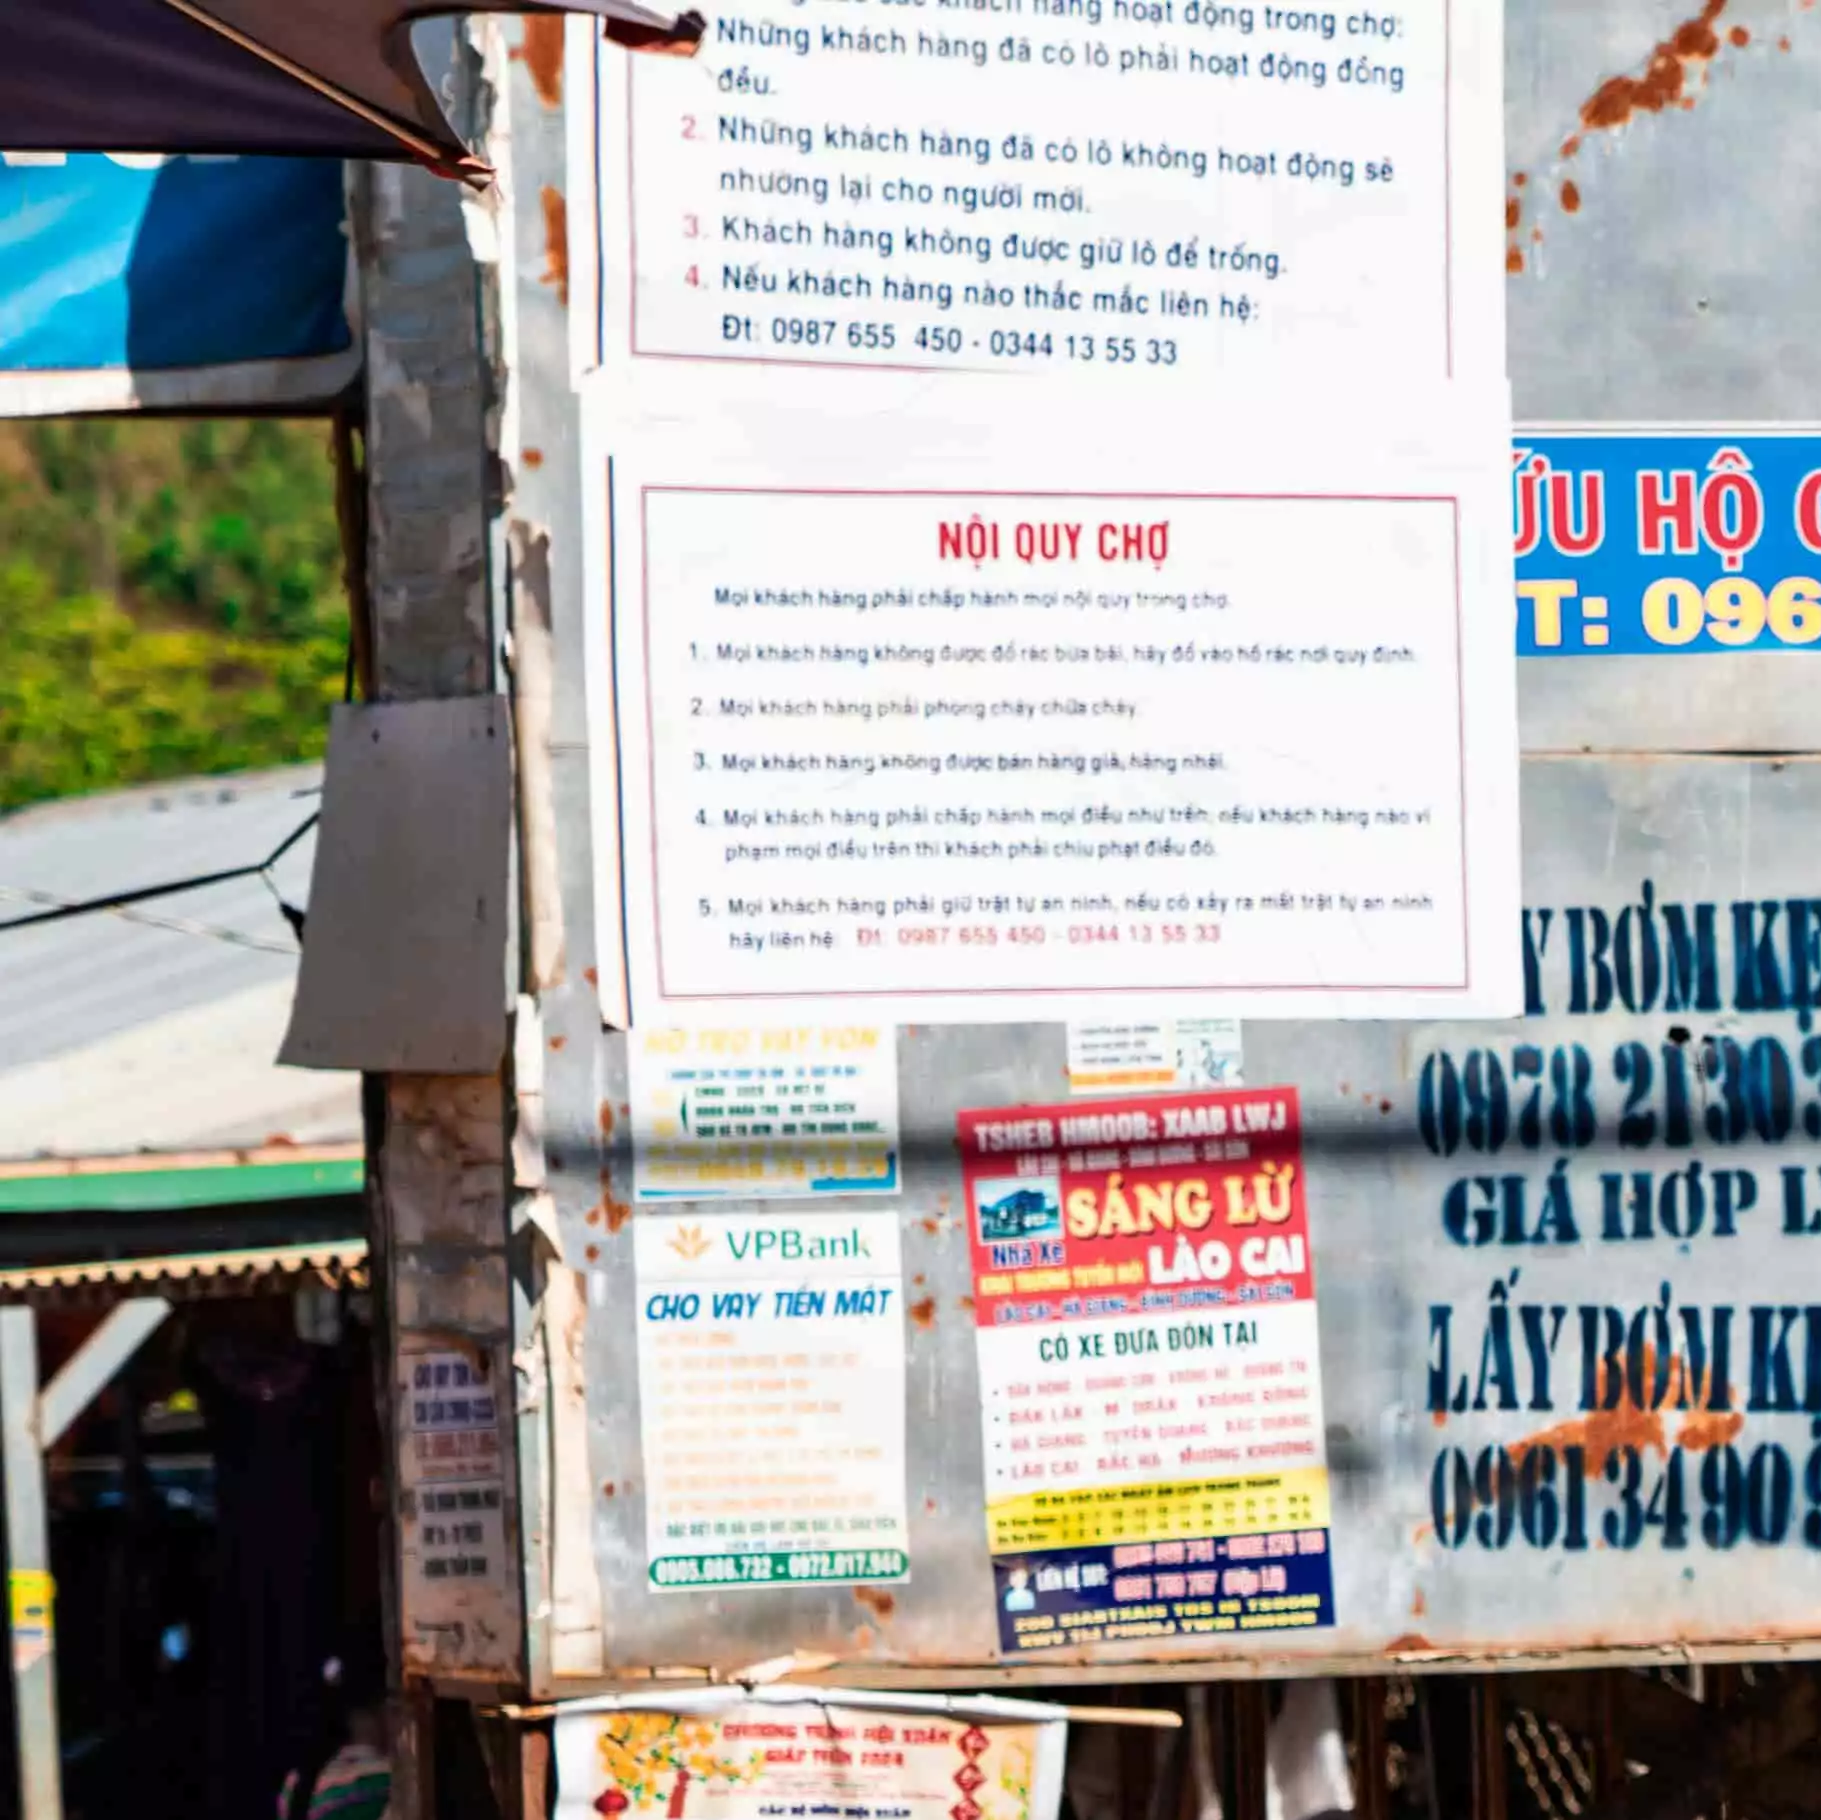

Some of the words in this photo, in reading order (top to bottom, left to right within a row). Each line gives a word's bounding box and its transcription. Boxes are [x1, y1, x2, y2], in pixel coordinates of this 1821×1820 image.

[1265, 5, 1336, 40] trong
[717, 18, 811, 56] Những
[821, 25, 906, 52] khách
[918, 31, 988, 67] hàng
[999, 36, 1032, 62] đã
[1042, 41, 1075, 66] có
[1120, 43, 1179, 75] phải
[1189, 49, 1249, 82] hoạt
[1260, 53, 1327, 88] động
[680, 114, 706, 142] 2.
[718, 116, 813, 154] Những
[824, 123, 909, 152] khách
[920, 128, 991, 165] hàng
[1001, 134, 1034, 162] đã
[1044, 137, 1078, 164] có
[1122, 141, 1208, 179] không
[1217, 146, 1277, 180] hoạt
[1287, 152, 1355, 188] động
[840, 173, 872, 208] lại
[882, 176, 934, 204] cho
[943, 181, 1023, 214] người
[722, 215, 812, 245] Khách
[823, 220, 894, 259] hàng
[904, 226, 992, 265] không
[1002, 233, 1071, 264] được
[722, 262, 778, 294] Nếu
[787, 268, 872, 298] khách
[883, 274, 954, 311] hàng
[963, 282, 1015, 310] nào
[1024, 279, 1082, 312] thắc
[1093, 283, 1150, 316] mắc
[1160, 289, 1209, 318] liên
[771, 316, 837, 346] 0987
[847, 321, 897, 351] 655
[913, 326, 963, 355] 450
[988, 330, 1054, 358] 0344
[1064, 335, 1095, 362] 13
[1104, 337, 1137, 365] 55
[1145, 339, 1178, 367] 33
[1636, 445, 1763, 569] HỘ
[937, 513, 1000, 572] NỘI
[1015, 521, 1083, 565] QUY
[1098, 520, 1170, 573] CHỢ
[714, 587, 750, 610] Mọi
[753, 587, 813, 608] khách
[818, 589, 868, 613] hàng
[722, 754, 757, 773] Mọi
[762, 753, 821, 772] khách
[826, 755, 875, 775] hàng
[881, 753, 941, 775] không
[1037, 754, 1087, 774] hàng
[1129, 754, 1178, 774] hàng
[1417, 1040, 1598, 1159] 0978
[1065, 1171, 1214, 1240] SÁNG
[1442, 1157, 1581, 1249] GIÁ
[1598, 1159, 1759, 1255] HỢP
[725, 1227, 873, 1261] VPBank
[1147, 1234, 1233, 1285] LÀO
[1239, 1233, 1307, 1278] CAI
[645, 1293, 702, 1321] CHO
[711, 1292, 763, 1320] VAY
[1038, 1331, 1070, 1364] CÓ
[1079, 1333, 1106, 1360] XE
[1114, 1327, 1160, 1357] ĐƯA
[1167, 1320, 1215, 1351] ĐÓN
[1426, 1266, 1568, 1414] LẤY
[1430, 1443, 1589, 1552] 0961
